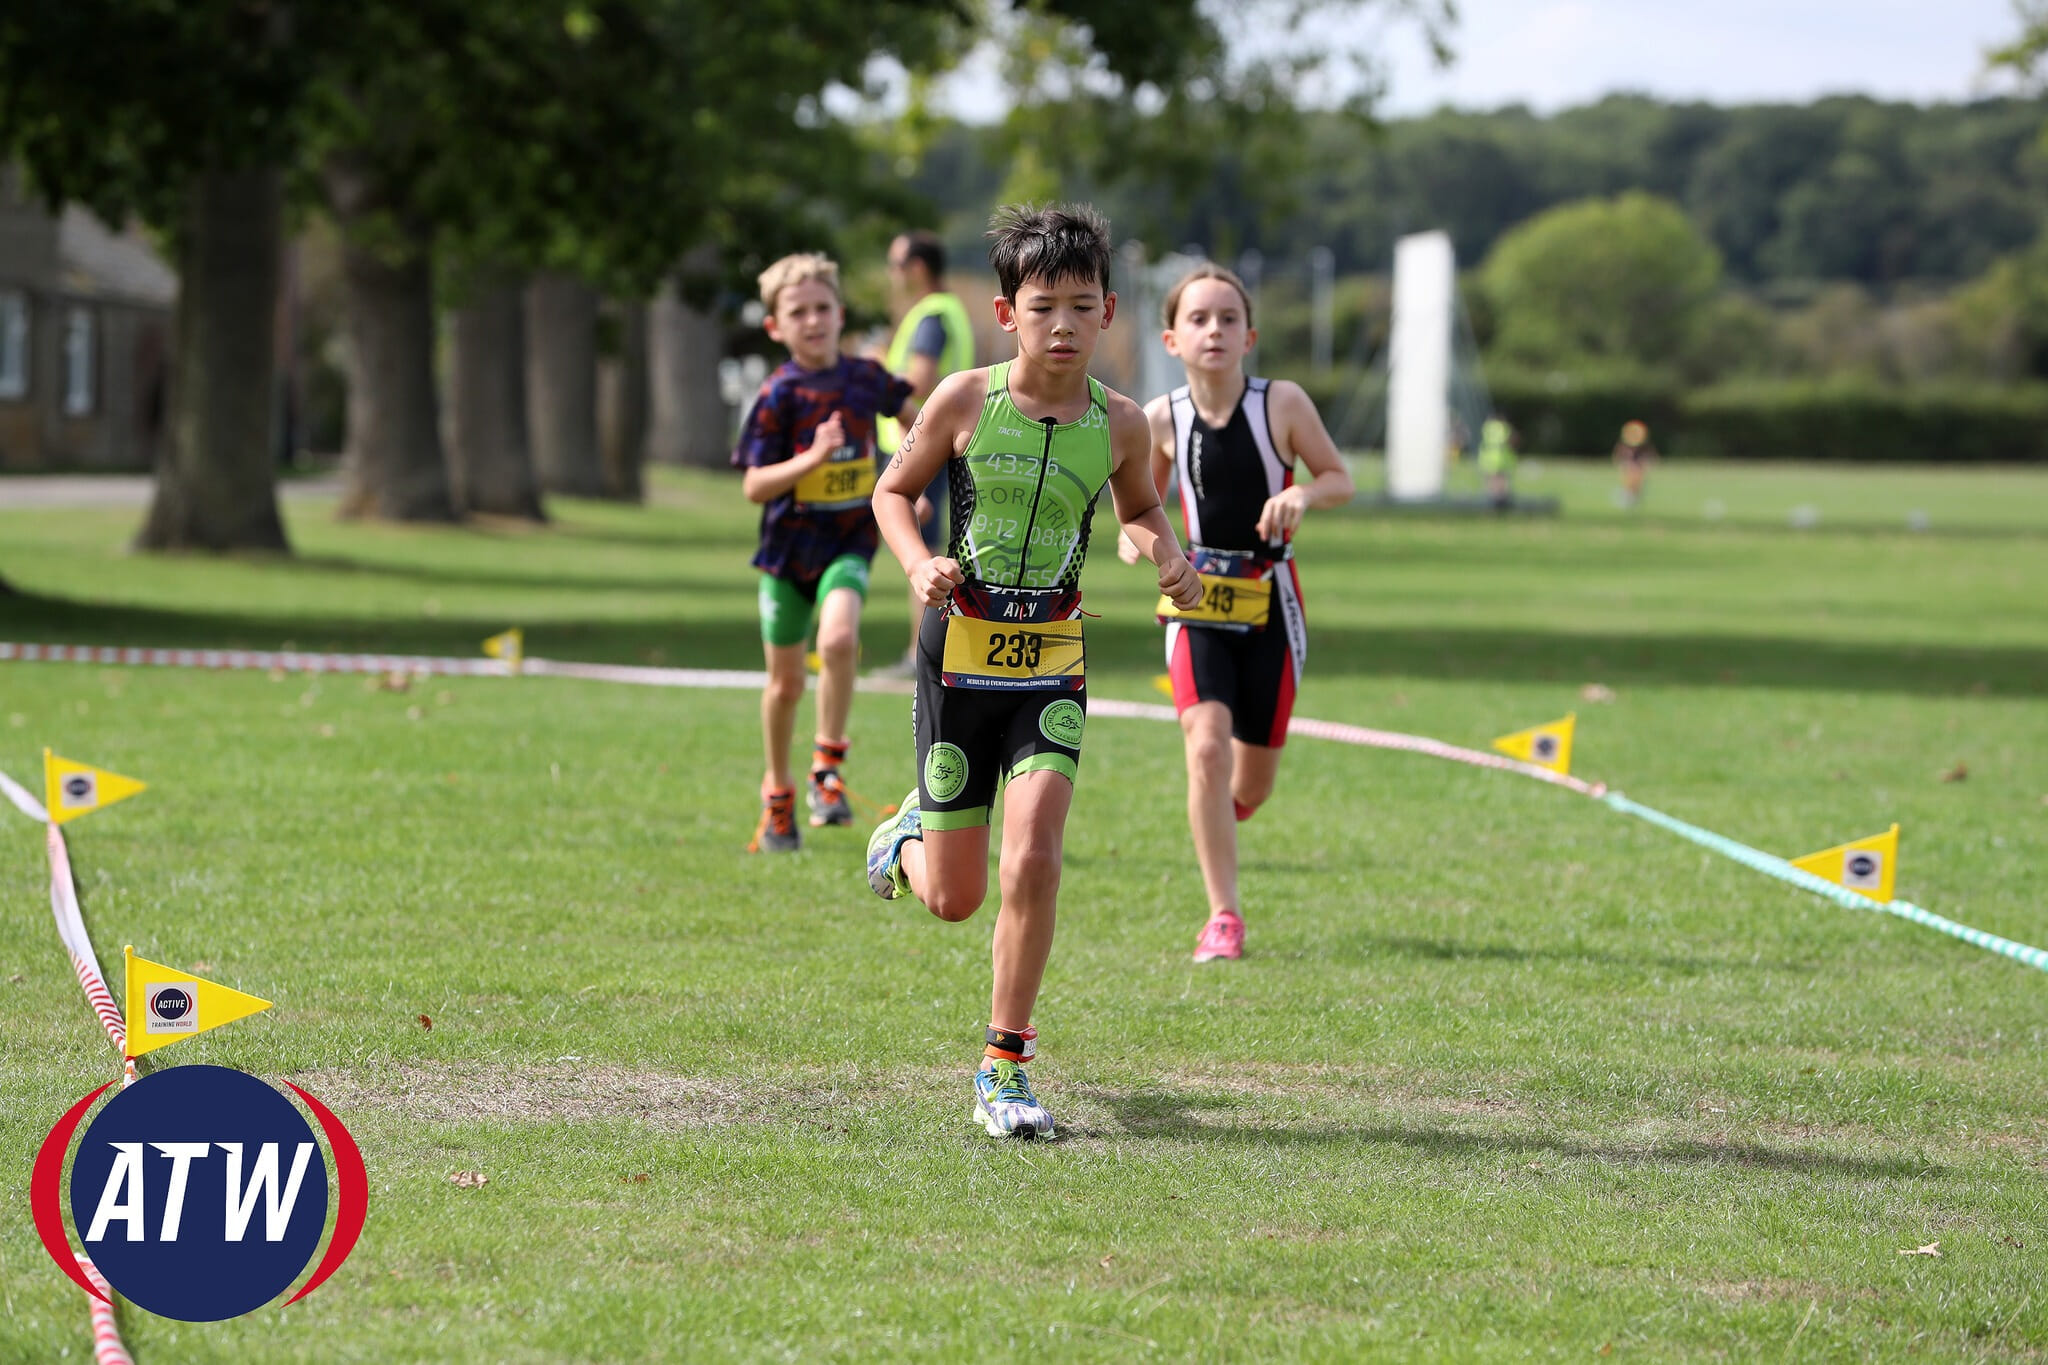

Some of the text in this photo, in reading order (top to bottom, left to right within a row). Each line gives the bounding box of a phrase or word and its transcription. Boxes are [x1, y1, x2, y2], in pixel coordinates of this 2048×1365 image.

[998, 426, 1023, 438] TACTIC
[986, 452, 1060, 477] 43:26
[986, 633, 1043, 668] 233
[157, 999, 186, 1009] ACTIVE
